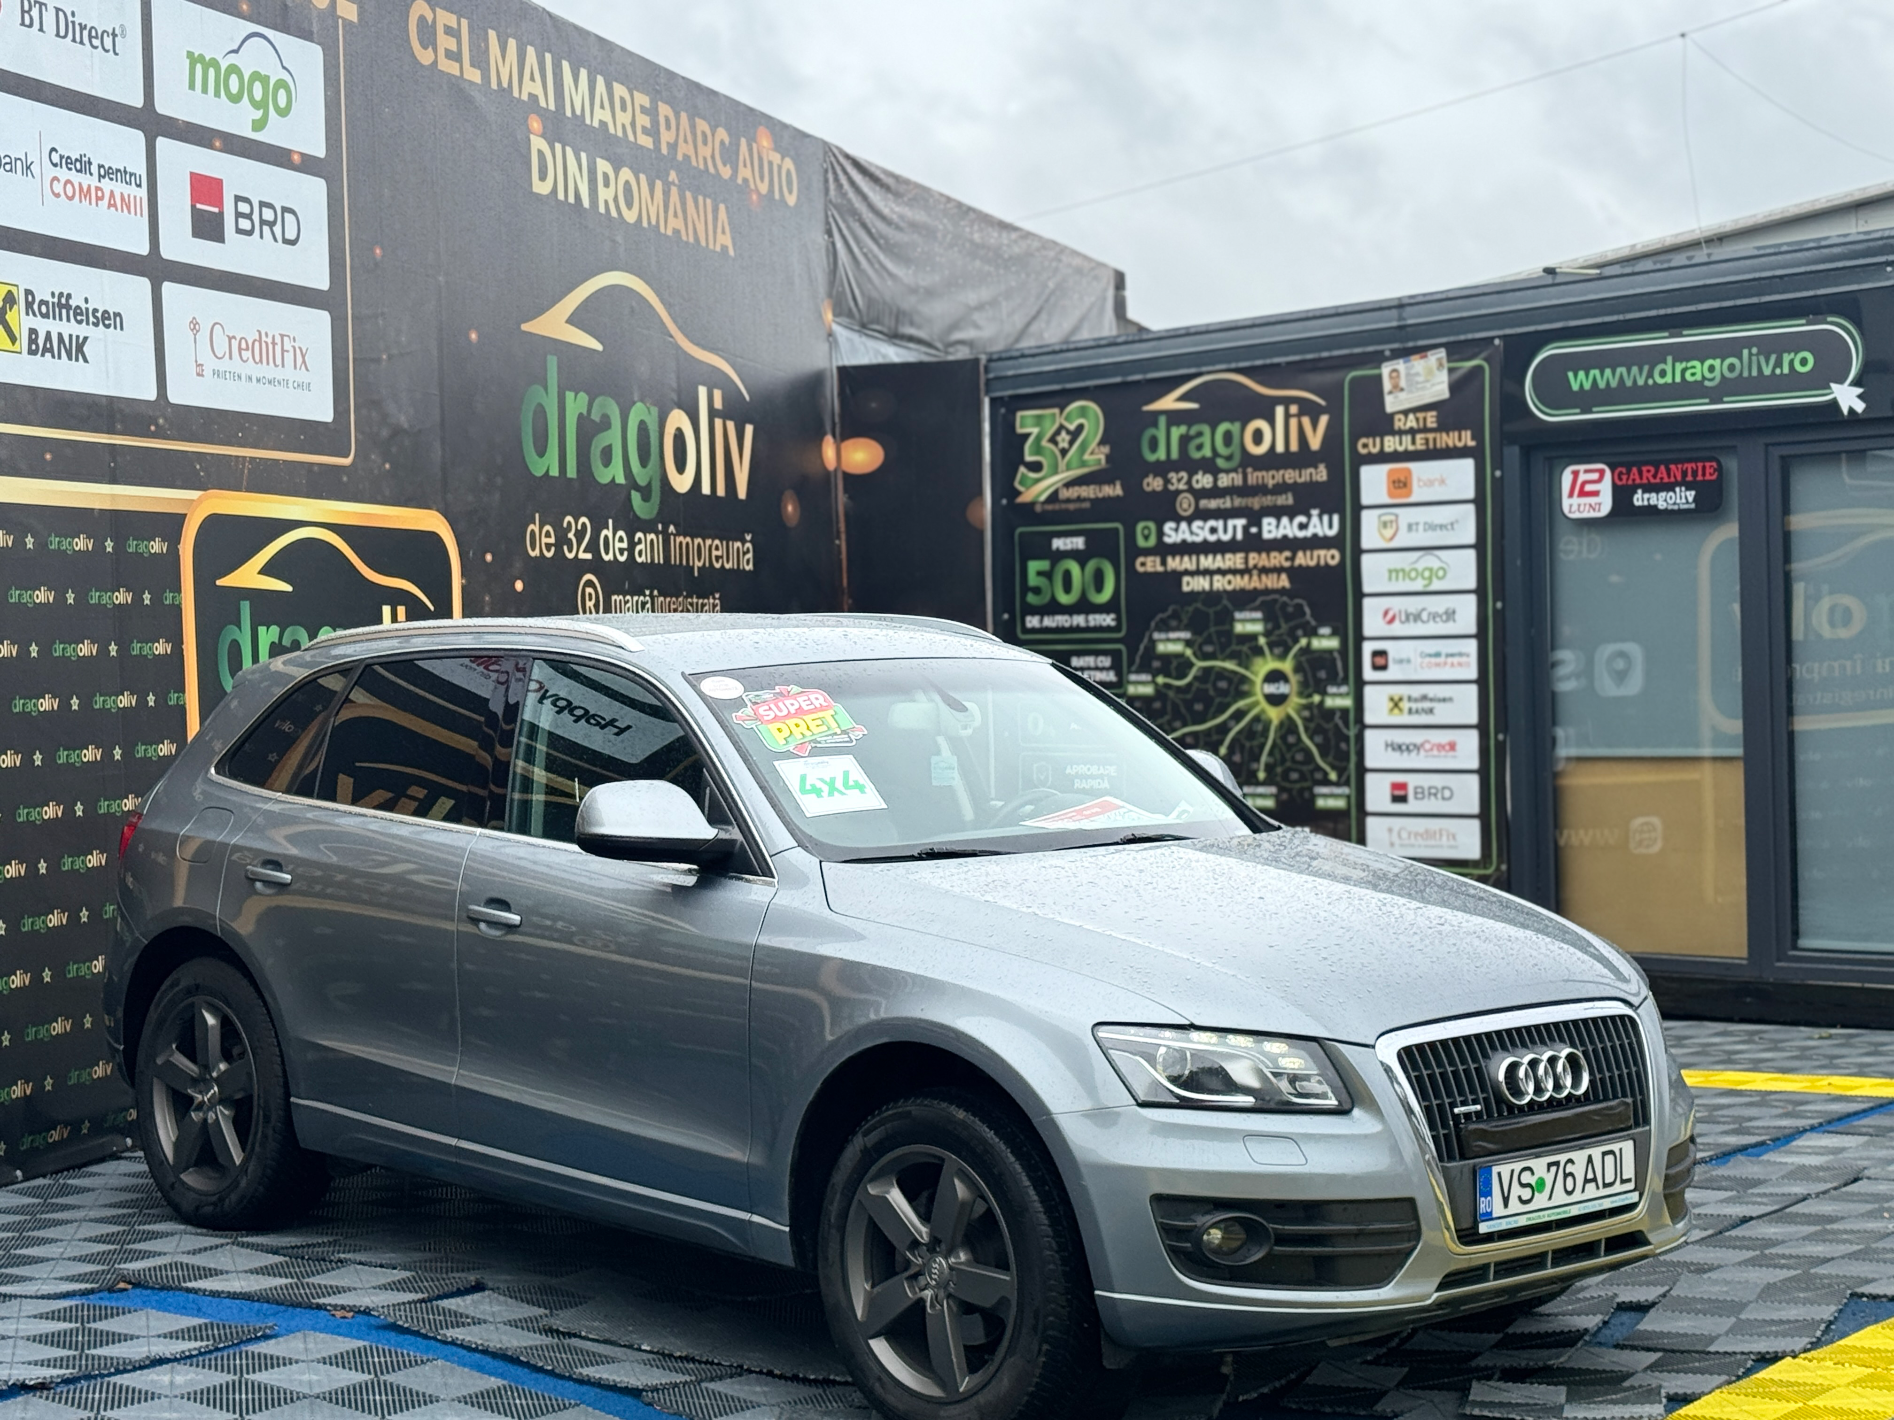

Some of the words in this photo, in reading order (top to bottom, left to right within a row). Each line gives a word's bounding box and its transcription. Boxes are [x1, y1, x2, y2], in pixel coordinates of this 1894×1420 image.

[20, 0, 48, 34] BT
[186, 50, 293, 133] mogo
[408, 0, 481, 84] CEL
[486, 28, 556, 111] MAI
[561, 59, 654, 150] MARE
[658, 100, 732, 179] PARC
[737, 137, 798, 208] AUTO
[48, 147, 94, 177] Credit
[97, 162, 143, 189] pentru
[49, 175, 144, 218] COMPANII
[530, 133, 589, 210] DIN
[596, 159, 735, 257] ROMÂNIA
[233, 194, 302, 247] BRD
[23, 288, 124, 332] Raiffeisen
[27, 328, 90, 364] BANK
[209, 321, 310, 373] CreditFix
[212, 368, 242, 383] PRIETEN
[256, 375, 290, 389] MOMENTE
[292, 380, 312, 393] CHEIE
[1567, 346, 1815, 391] www.dragoliv.ro
[1393, 411, 1438, 430] RATE
[521, 355, 753, 519] dragoliv
[1014, 400, 1104, 493] 32
[1141, 404, 1330, 469] dragoliv
[1356, 437, 1381, 454] CU
[1383, 430, 1477, 452] BULETINUL
[1142, 473, 1164, 492] de
[1167, 472, 1189, 490] 32
[1191, 471, 1214, 489] de
[1217, 470, 1243, 488] ani
[1246, 463, 1328, 489] împreună
[1416, 475, 1448, 489] bank
[1567, 468, 1606, 499] 12
[1613, 461, 1719, 486] GARANTIE
[1568, 502, 1602, 514] LUNI
[1633, 486, 1696, 510] dragoliv
[1162, 518, 1248, 544] SASCUT
[1261, 508, 1340, 540] BACĂU
[1423, 518, 1459, 534] Direct
[48, 533, 94, 552] dragoliv
[126, 536, 168, 556] dragoliv
[526, 513, 556, 559] de
[562, 515, 593, 560] 32
[599, 518, 628, 563] de
[634, 524, 664, 565] ani
[669, 524, 754, 577] împreună
[1052, 536, 1086, 551] PESTE
[1135, 555, 1164, 573] CEL
[1166, 554, 1197, 572] MAI
[1199, 552, 1246, 571] MARE
[1249, 550, 1292, 569] PARC
[1293, 548, 1341, 567] AUTO
[1025, 557, 1116, 606] 500
[1181, 575, 1211, 592] DIN
[1212, 569, 1291, 592] ROMÂNIA
[1387, 565, 1447, 588] mogo
[8, 586, 55, 607] dragoliv
[88, 587, 133, 607] dragoliv
[1042, 614, 1072, 628] AUTO
[1088, 613, 1118, 627] STOC
[1398, 608, 1457, 625] UniCredit
[52, 639, 98, 660] dragoliv
[130, 638, 172, 659] dragoliv
[12, 694, 59, 715] dragoliv
[93, 691, 137, 711] dragoliv
[758, 693, 829, 721] SUPER
[56, 745, 102, 766] dragoliv
[135, 739, 177, 760] dragoliv
[1384, 740, 1458, 756] HappyCredit
[799, 770, 867, 798] 4x4
[1413, 785, 1455, 802] BRD
[16, 801, 64, 824] dragoliv
[61, 850, 107, 873] dragoliv
[20, 910, 68, 933] dragoliv
[1480, 1197, 1492, 1213] RO
